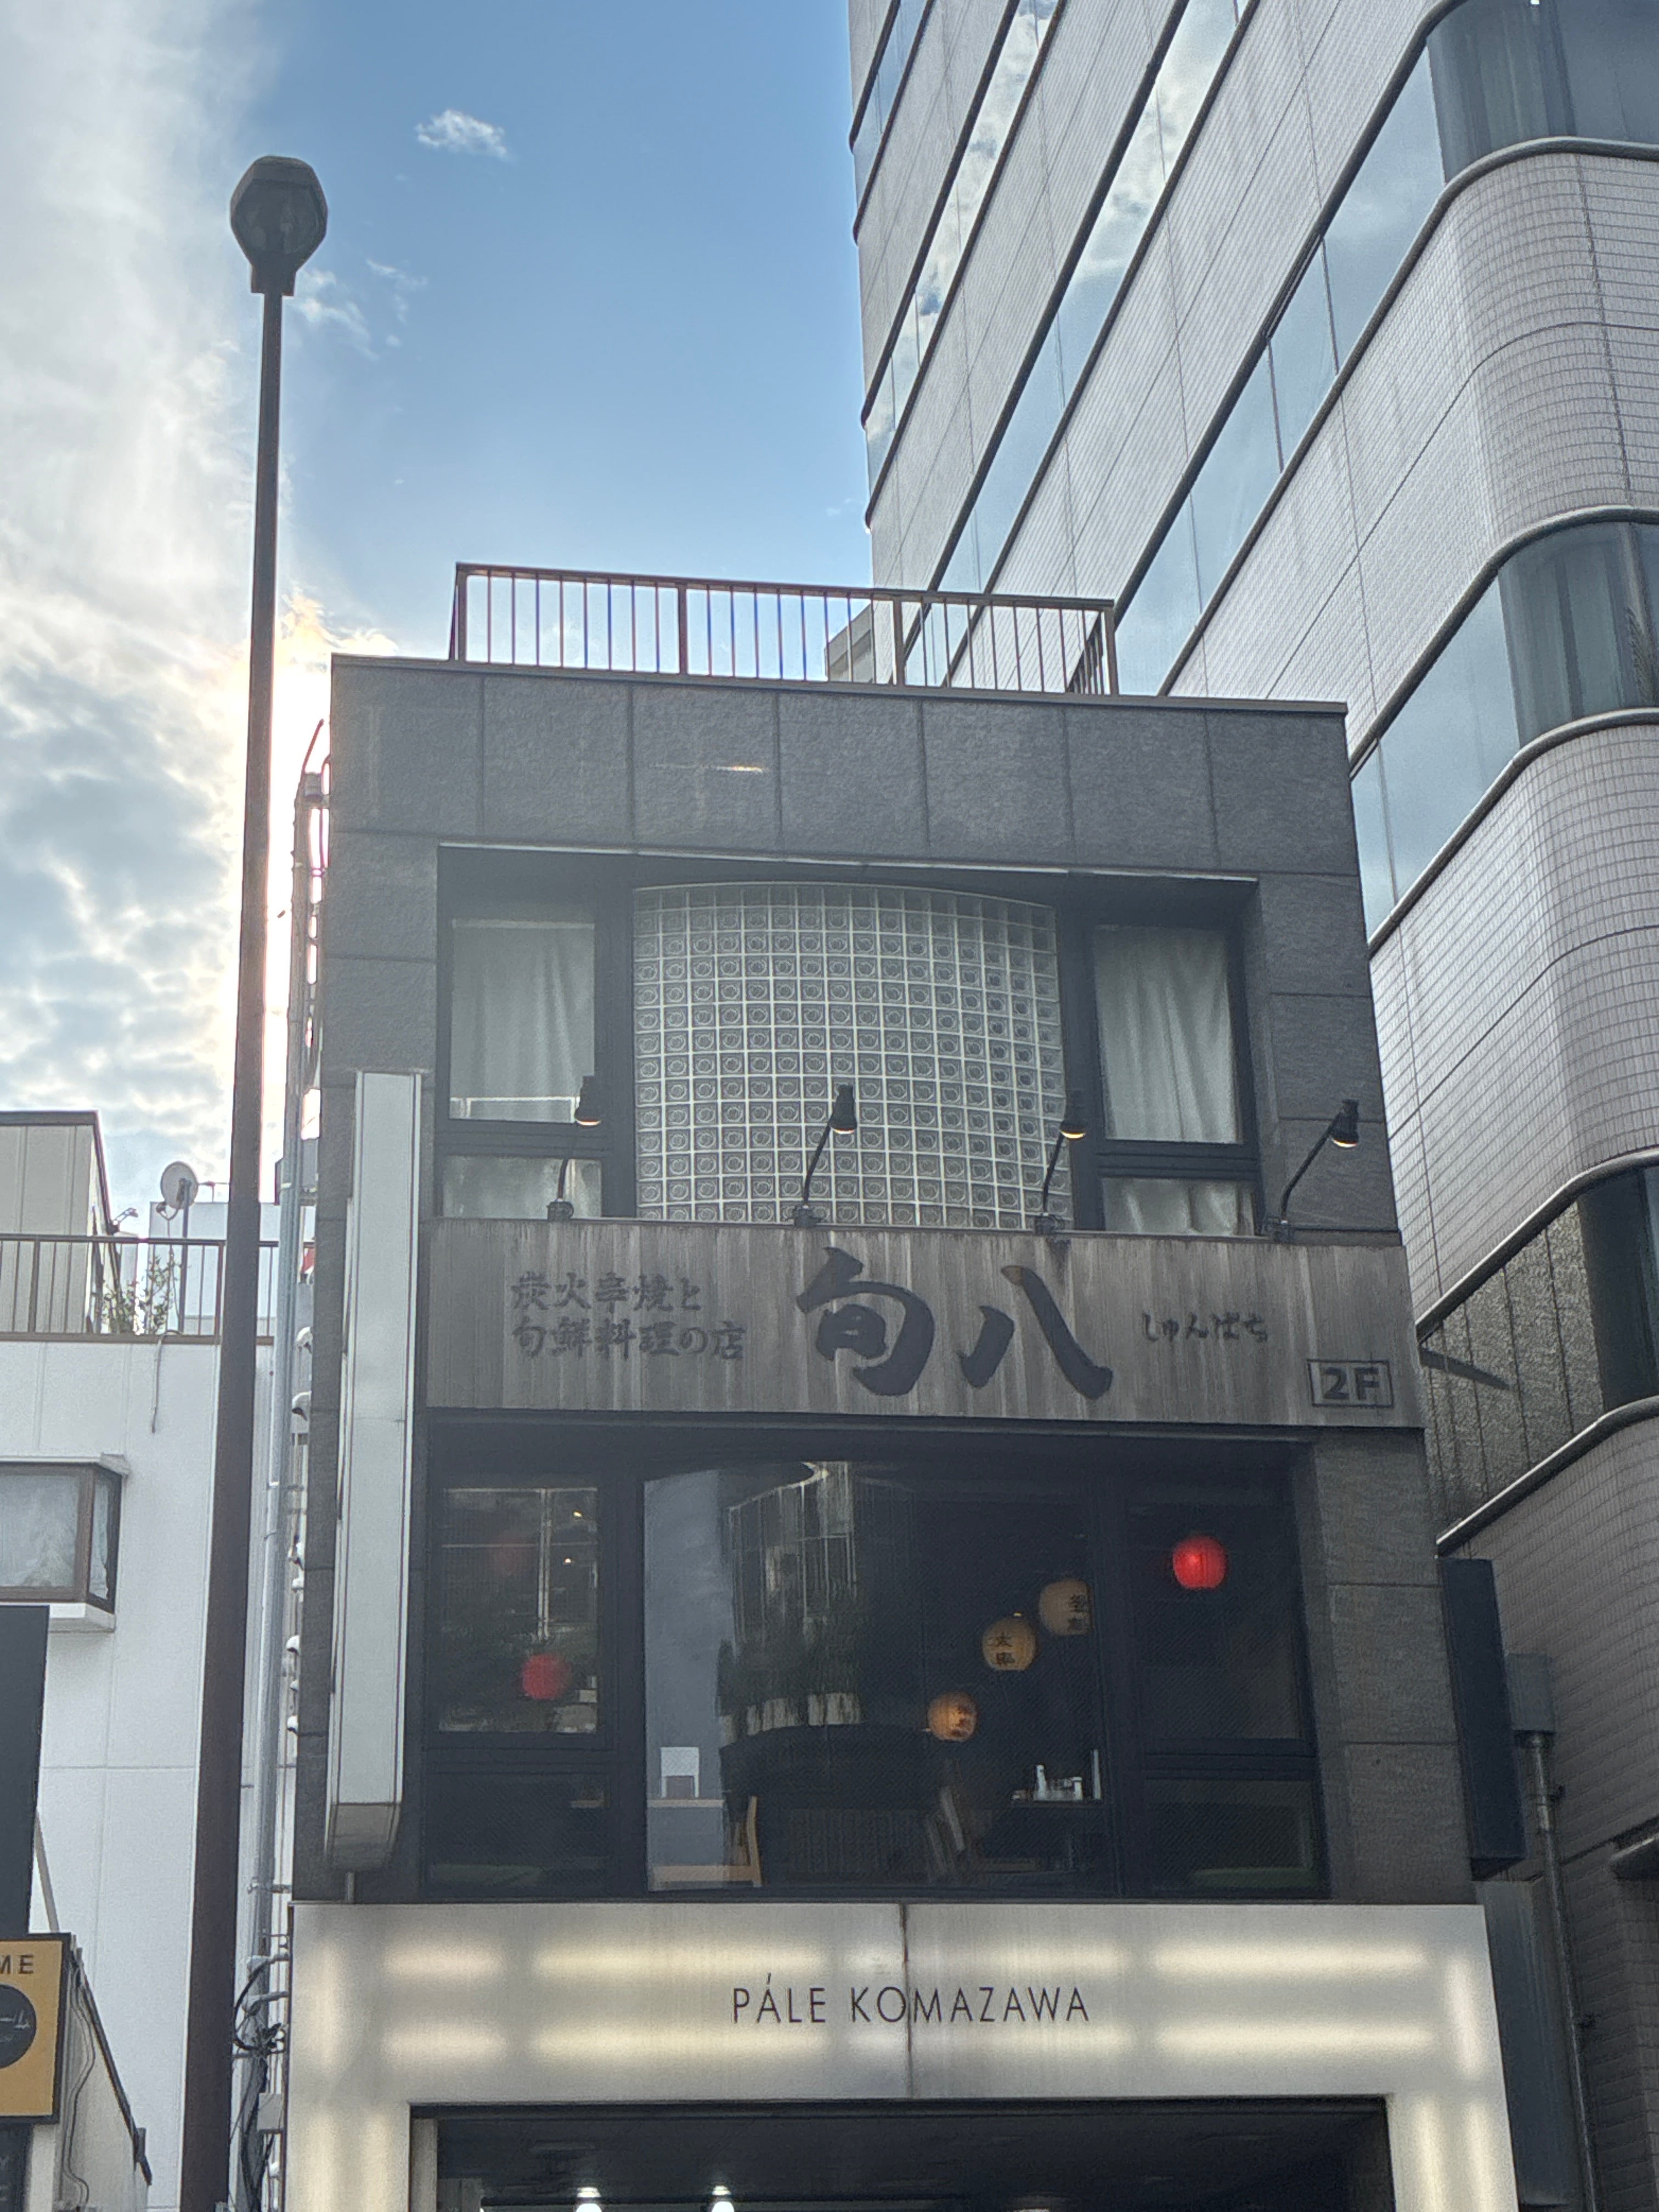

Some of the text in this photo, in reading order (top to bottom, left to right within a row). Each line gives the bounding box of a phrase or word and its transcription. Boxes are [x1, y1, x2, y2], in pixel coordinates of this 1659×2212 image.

[511, 1316, 746, 1361] 旬鮮料理の店
[796, 1246, 1114, 1400] 旬八
[1322, 1367, 1380, 1401] 2F
[851, 1986, 1089, 2023] KOMAZAWA
